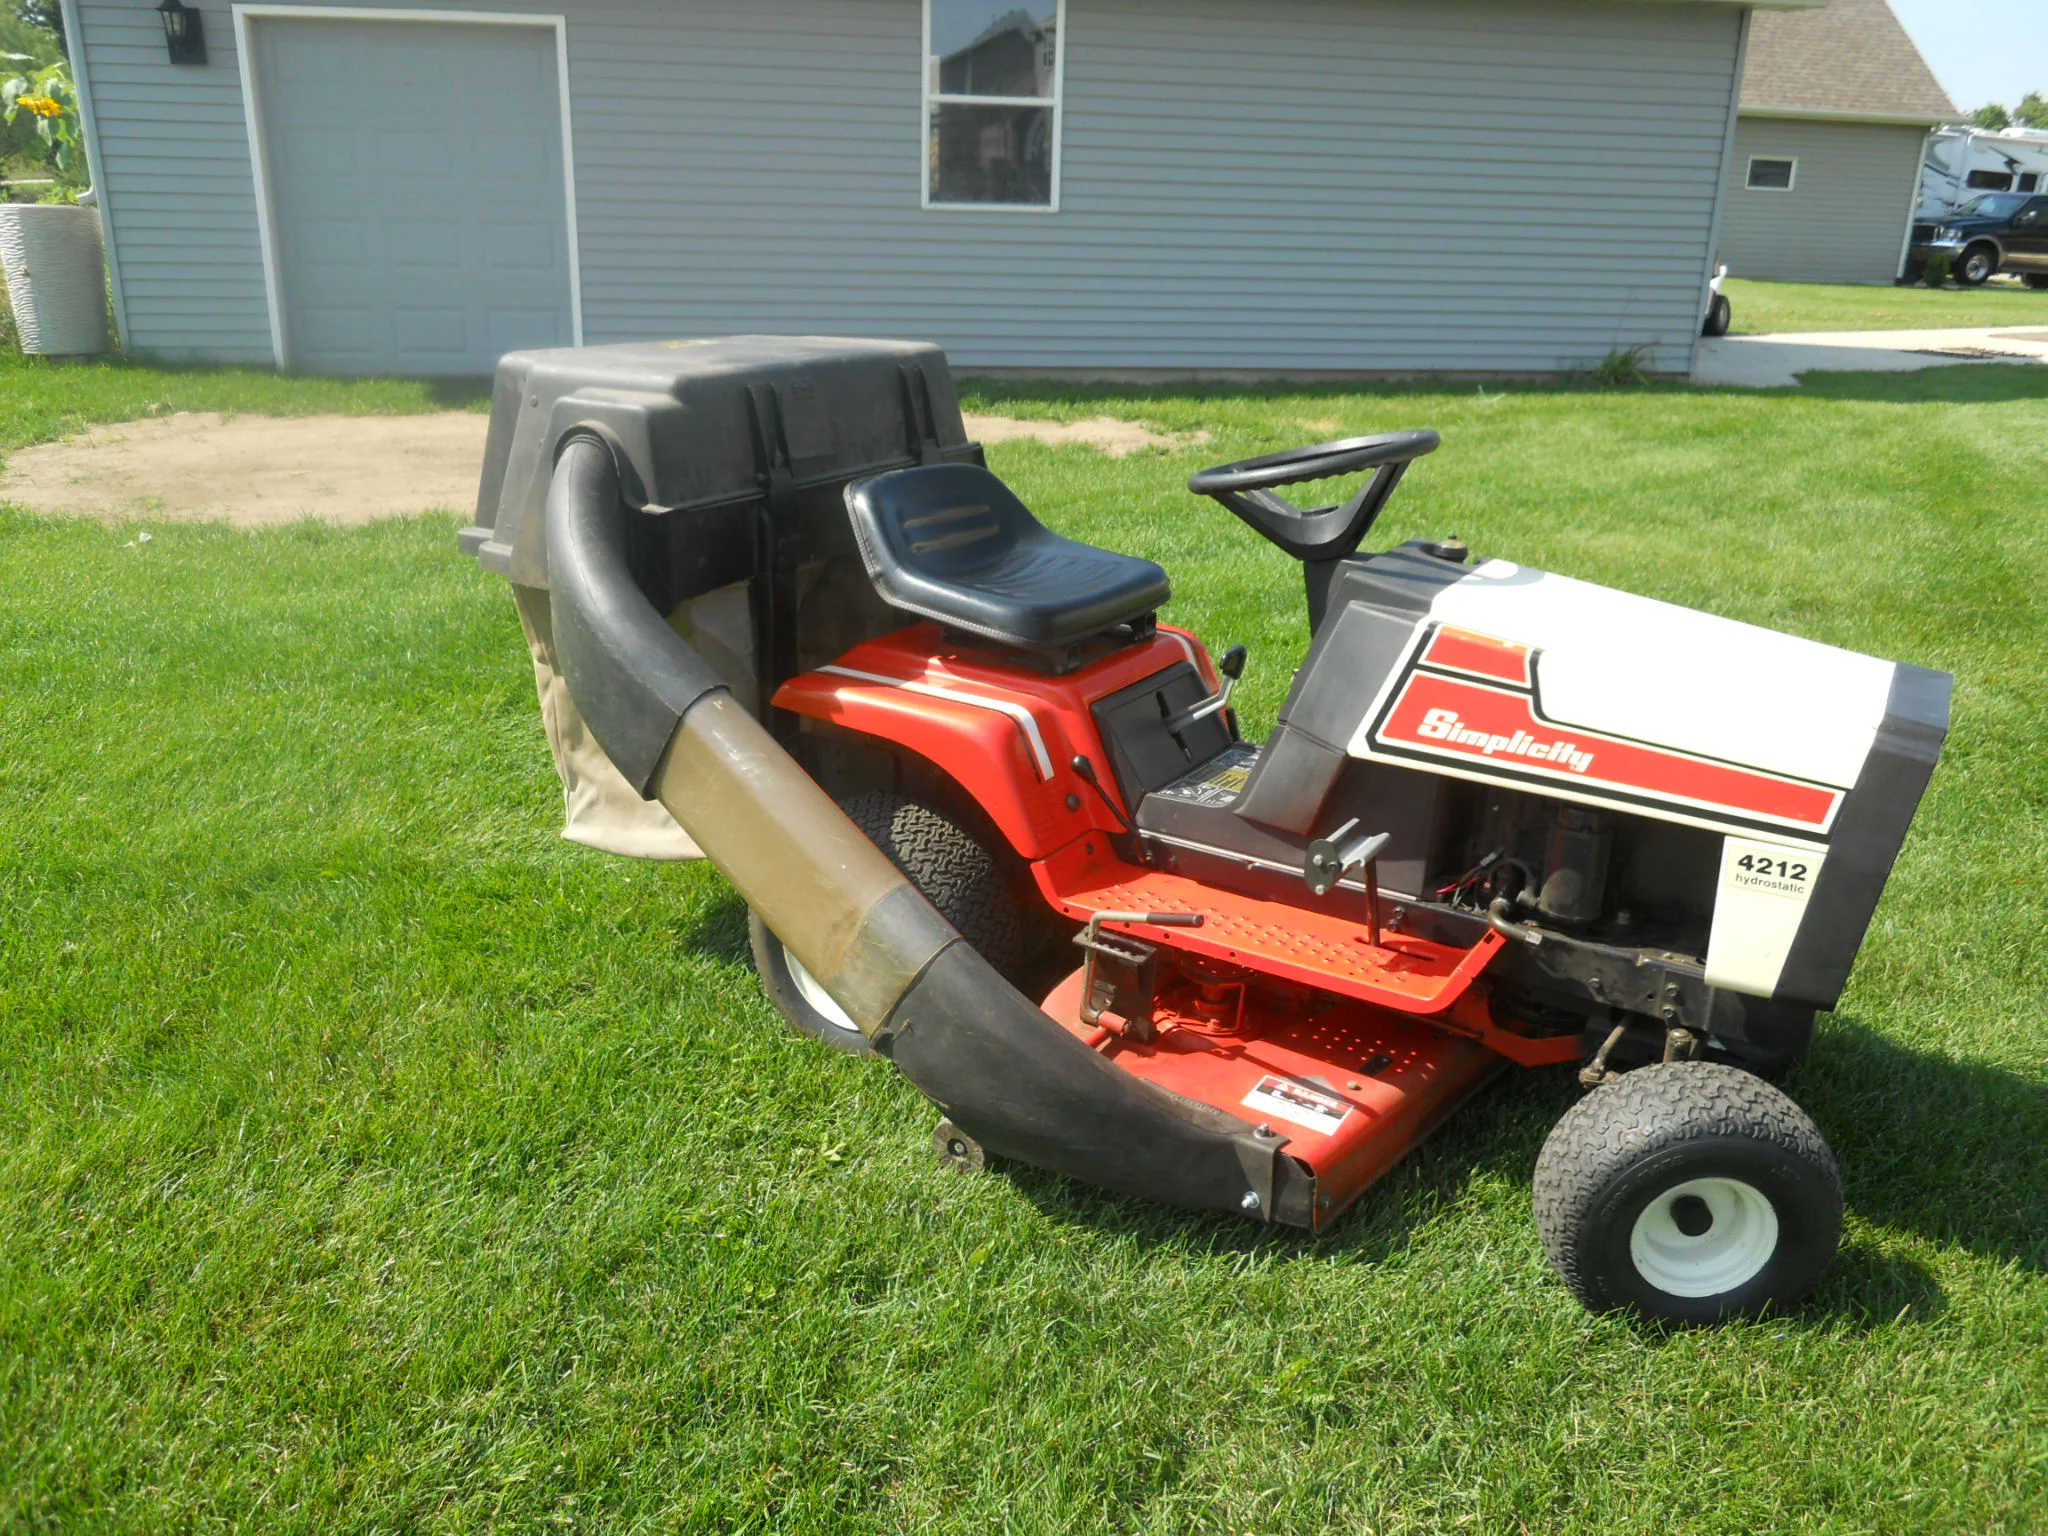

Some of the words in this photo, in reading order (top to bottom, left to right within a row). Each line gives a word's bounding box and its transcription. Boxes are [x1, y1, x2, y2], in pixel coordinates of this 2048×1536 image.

[1417, 708, 1594, 773] Simplicity
[1737, 854, 1808, 881] 4212
[1735, 873, 1805, 894] hydrostatic
